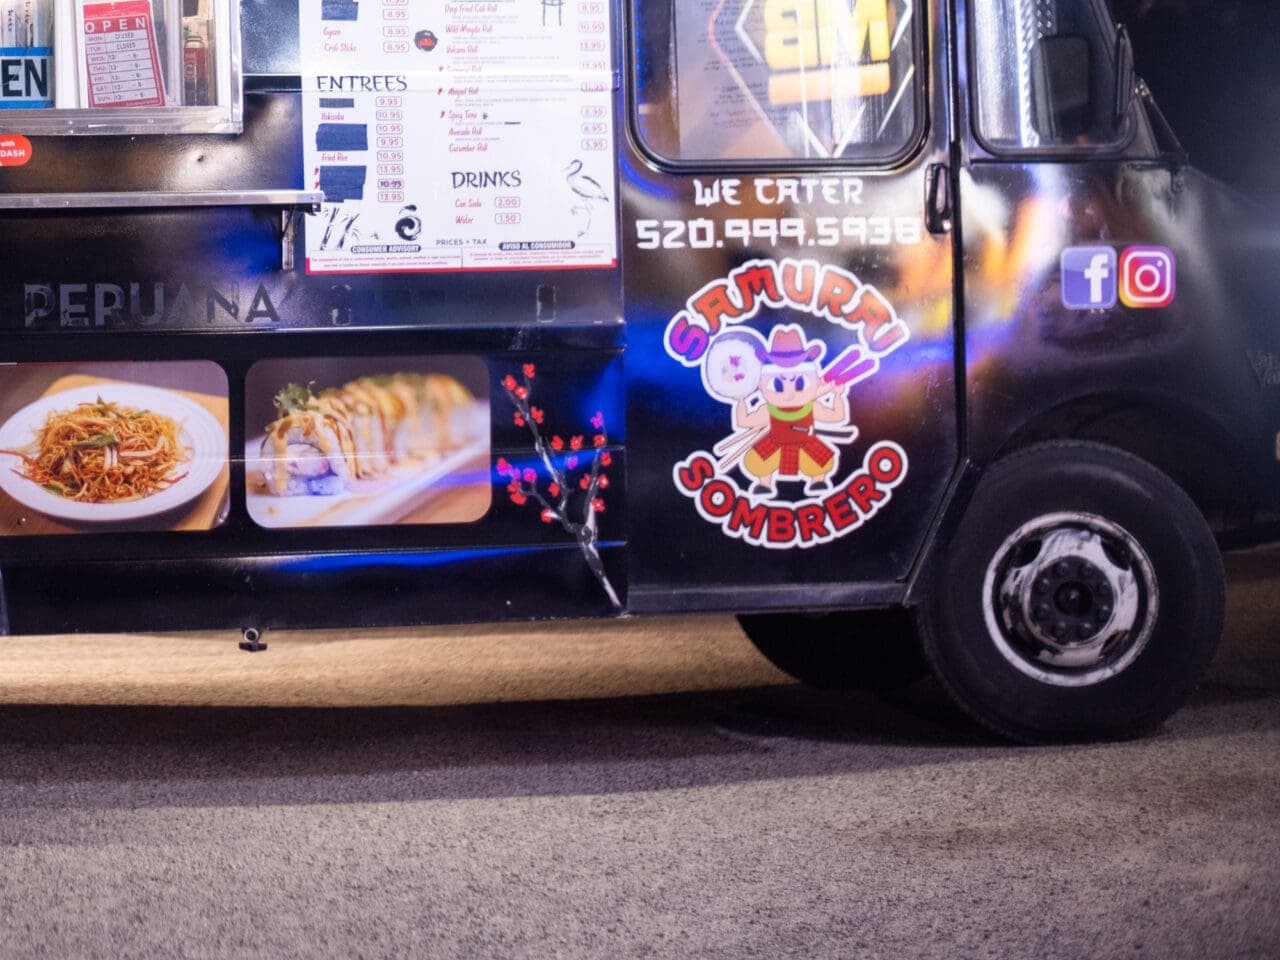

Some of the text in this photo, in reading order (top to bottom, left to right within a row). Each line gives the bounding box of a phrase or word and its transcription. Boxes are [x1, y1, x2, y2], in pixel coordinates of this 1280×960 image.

[85, 16, 146, 33] OPEN
[317, 76, 408, 92] ENTREES
[451, 170, 521, 188] DRINKS
[693, 178, 864, 207] WE CATER
[635, 217, 921, 249] 520.999.5938
[24, 282, 280, 327] PERUANA
[667, 261, 908, 363] SAMURAI
[676, 444, 906, 545] SOMBRERO
